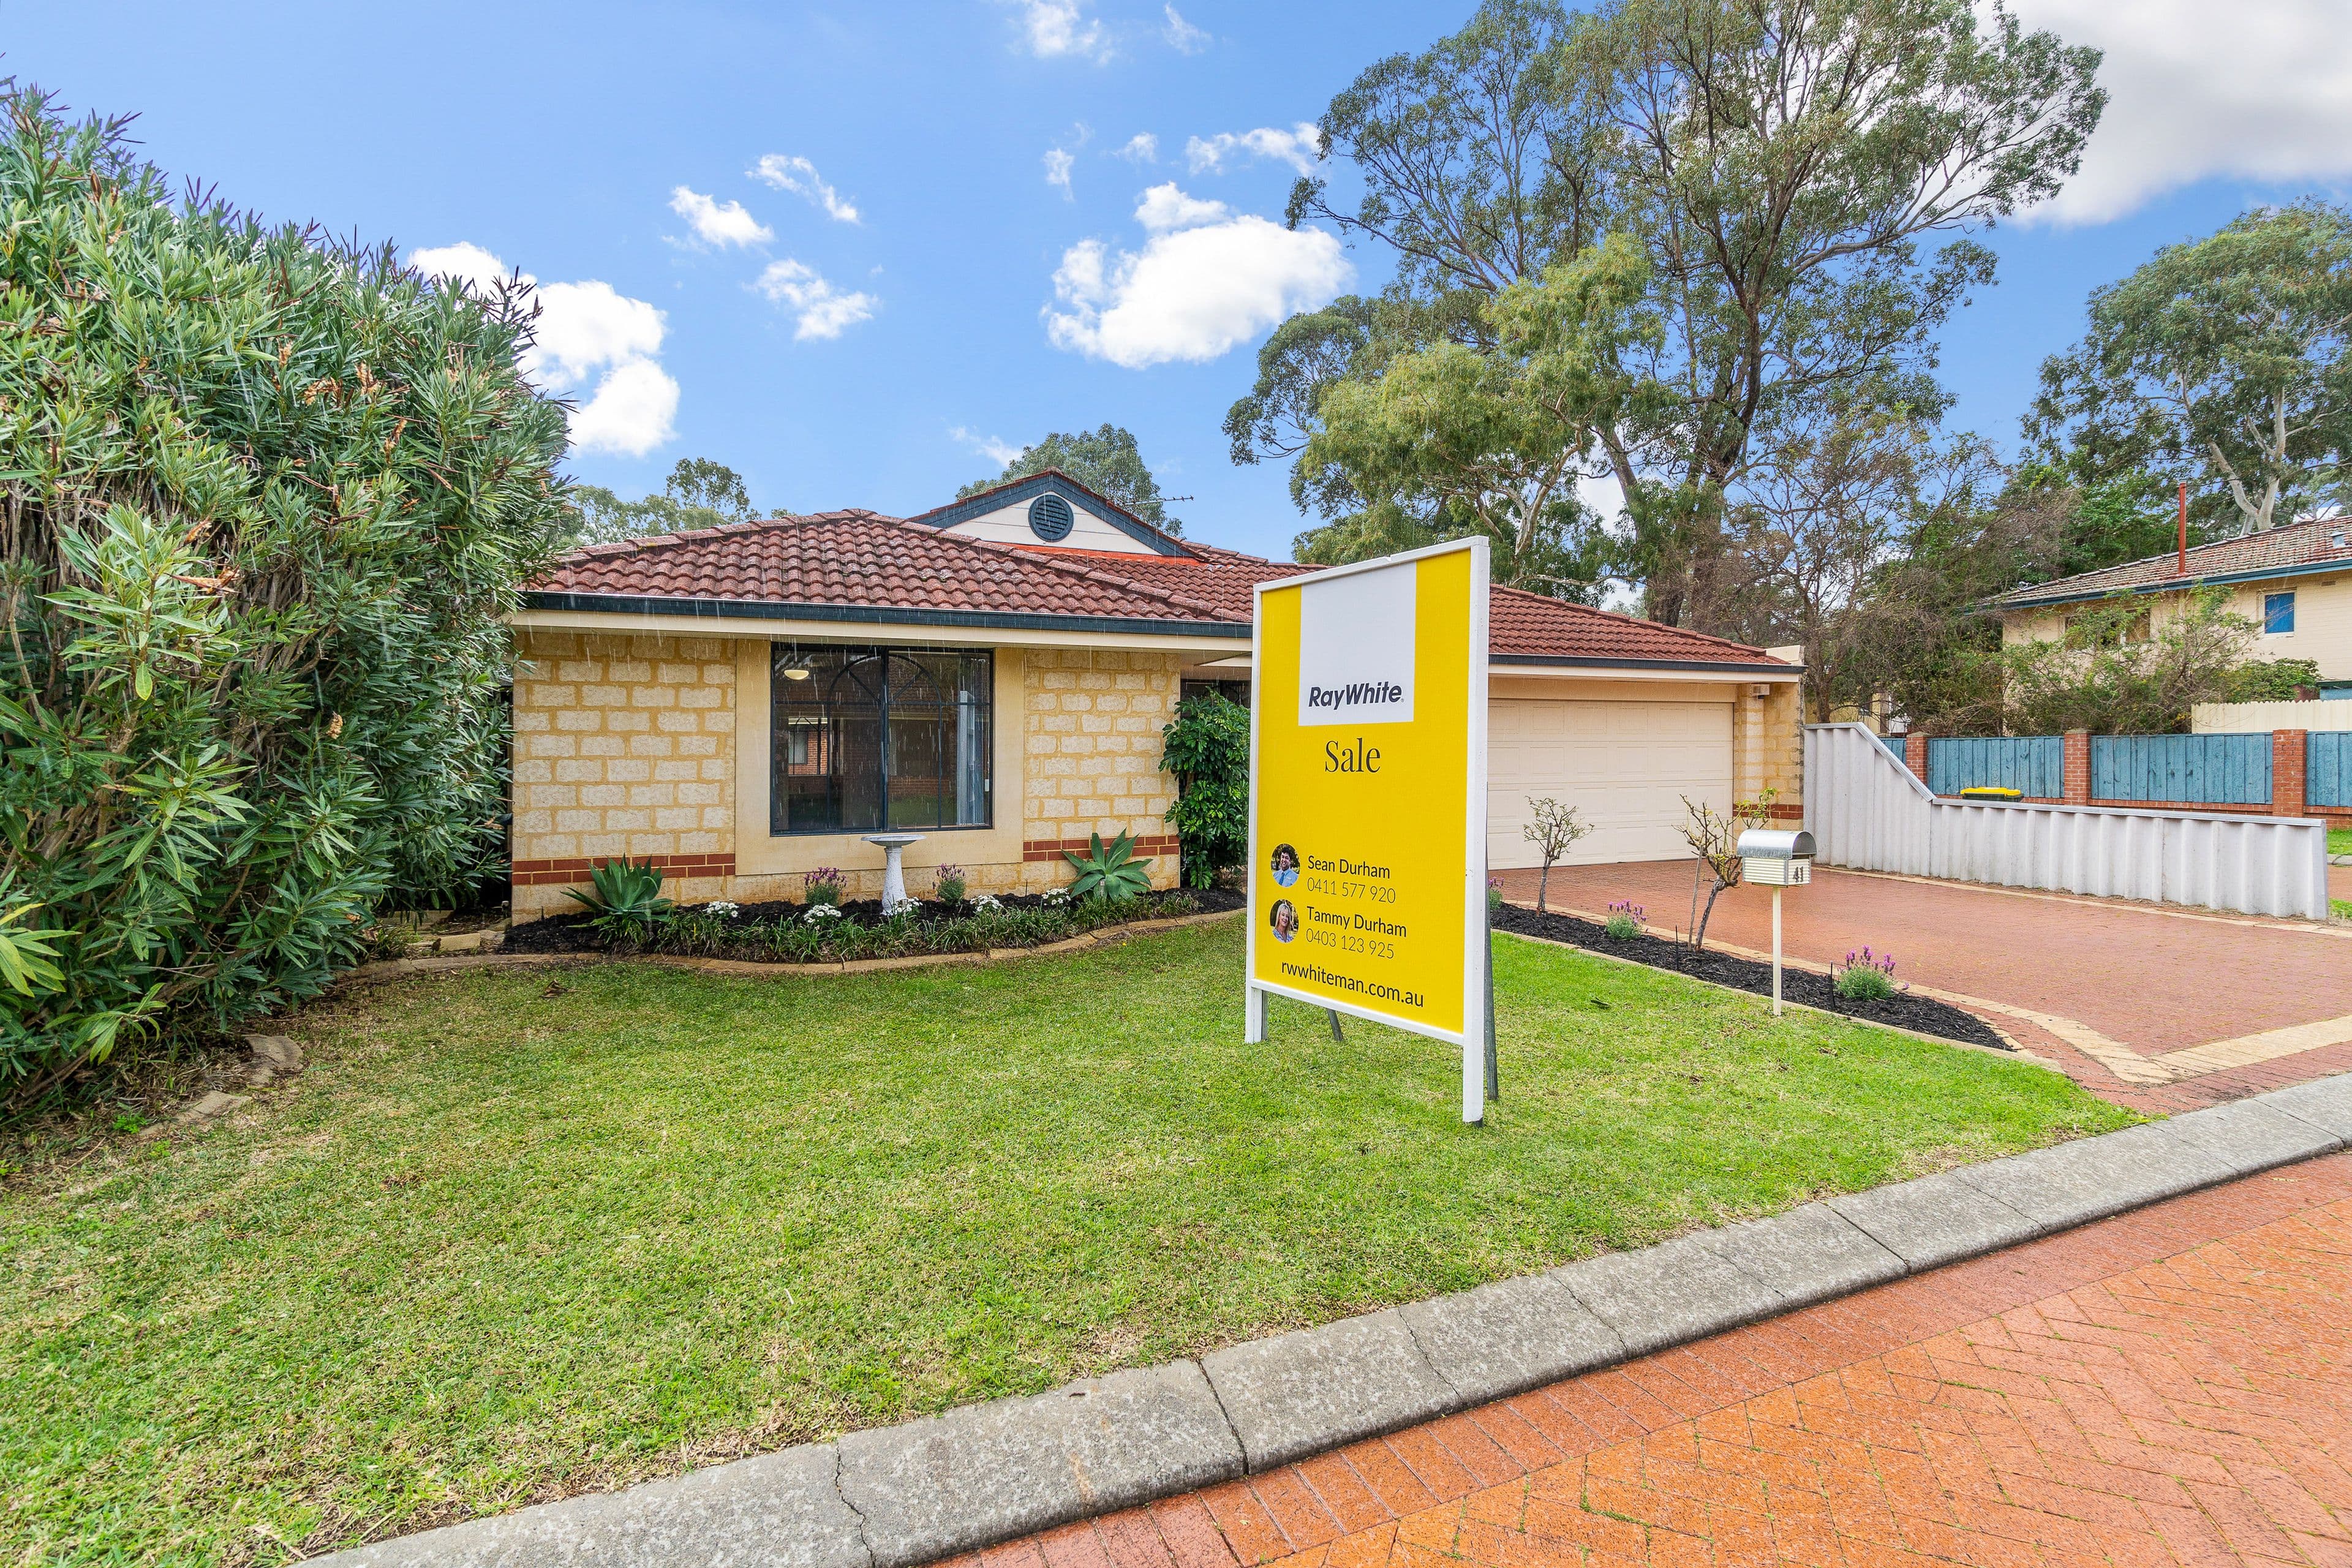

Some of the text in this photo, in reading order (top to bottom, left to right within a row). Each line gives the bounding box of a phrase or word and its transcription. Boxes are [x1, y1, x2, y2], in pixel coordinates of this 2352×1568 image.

[1324, 737, 1381, 773] Sale
[1308, 855, 1390, 879] Sean Durham
[1792, 866, 1804, 883] 41
[1307, 877, 1396, 903] 0411 577 920
[1306, 906, 1407, 937] Tammy Durham
[1306, 928, 1395, 959] 0403 123 925
[1281, 961, 1423, 1008] rwwhiteman.com.au
